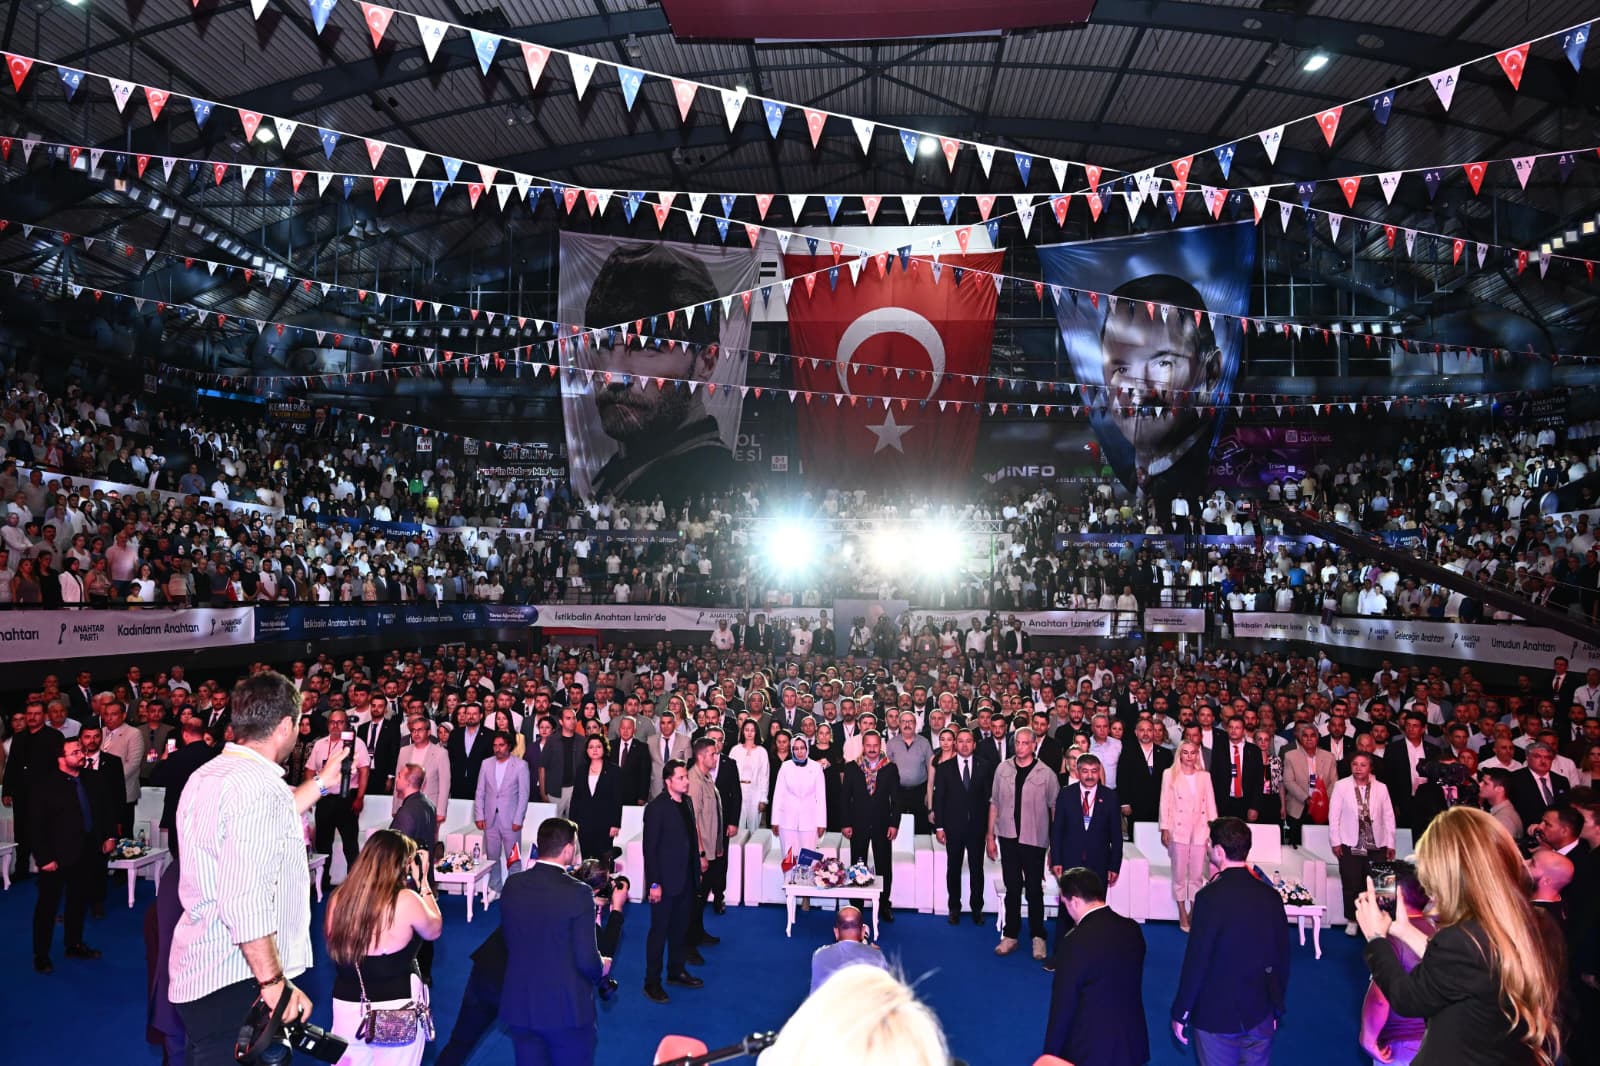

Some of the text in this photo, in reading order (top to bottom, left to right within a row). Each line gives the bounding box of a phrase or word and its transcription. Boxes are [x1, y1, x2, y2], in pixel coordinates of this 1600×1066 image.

[554, 610, 667, 622] İstikbalin Anahtarı İzmir'de
[73, 624, 105, 633] ANAHTAR
[164, 622, 200, 634] Anahtarı
[1029, 618, 1069, 628] Anahtarı
[79, 632, 99, 642] PARTİ
[1491, 637, 1557, 652] Umudun Anahtarı
